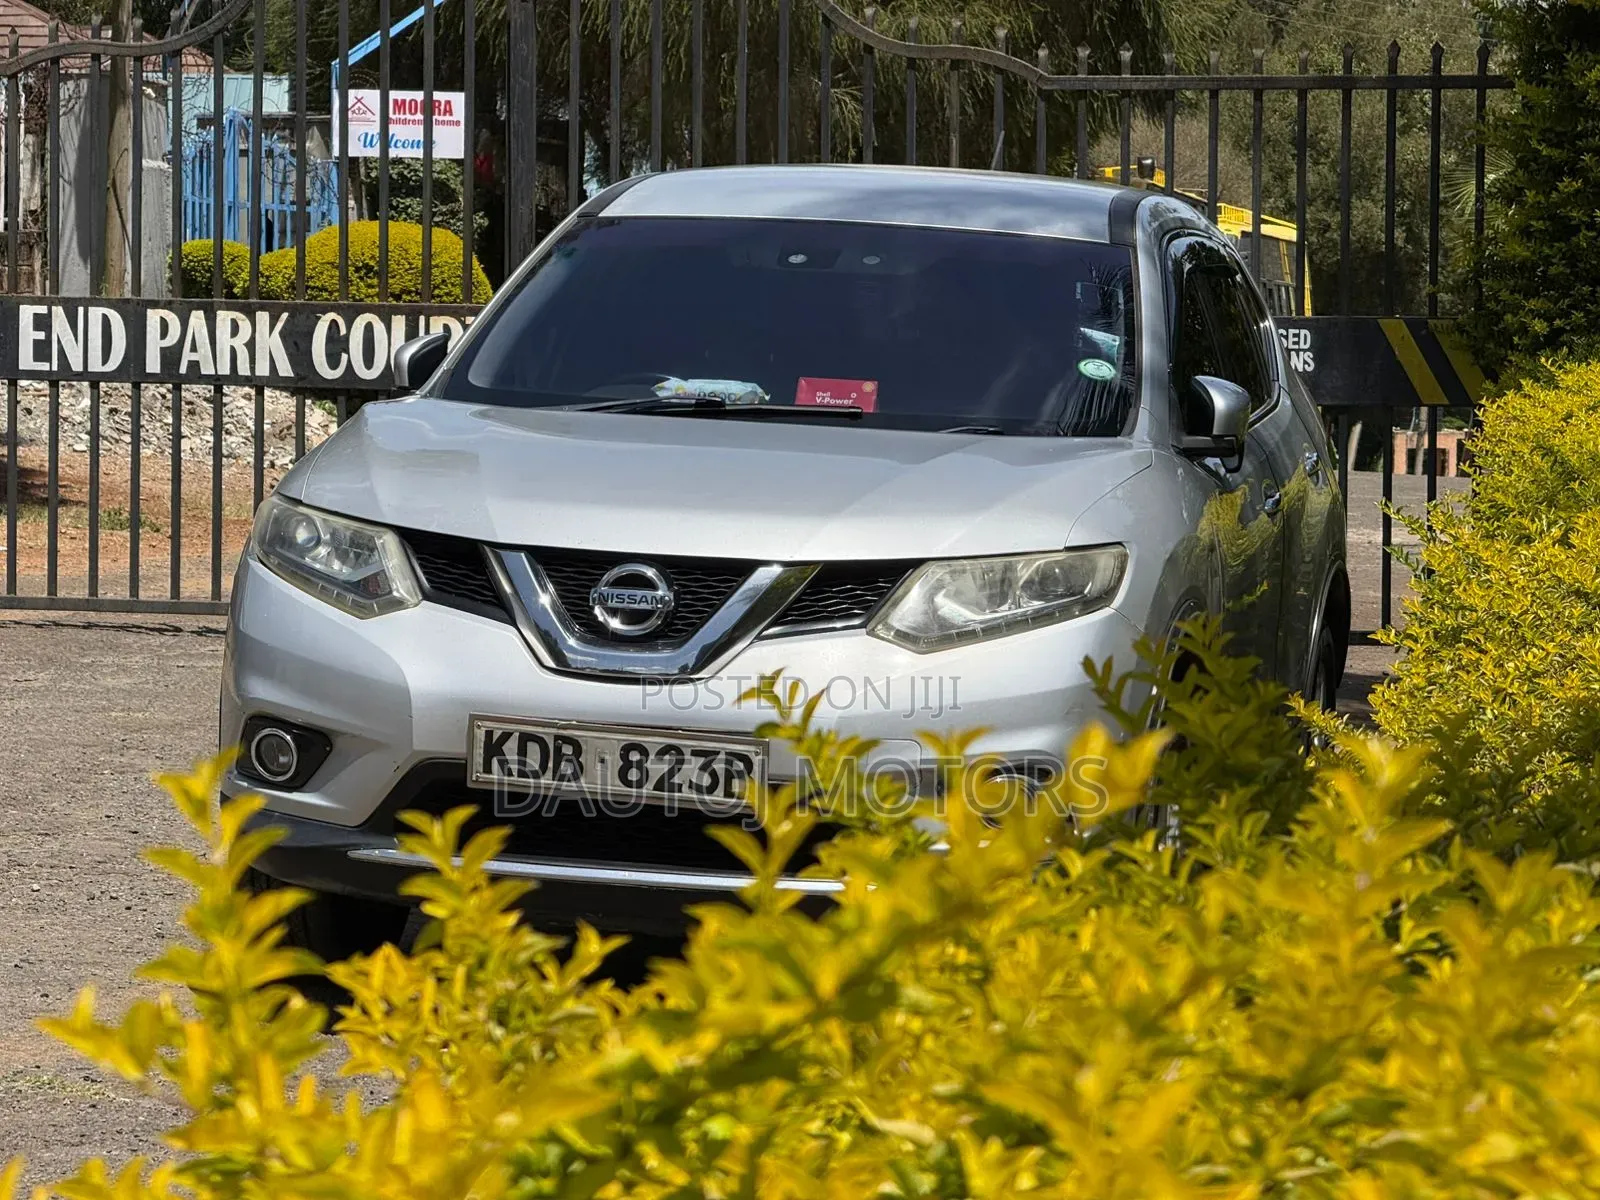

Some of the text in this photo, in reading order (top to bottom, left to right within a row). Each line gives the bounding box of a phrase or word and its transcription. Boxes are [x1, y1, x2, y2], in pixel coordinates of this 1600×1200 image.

[388, 117, 461, 127] hildren home
[357, 132, 436, 149] Wlcom
[18, 305, 127, 372] END
[145, 308, 295, 378] PARK
[815, 397, 854, 405] V-Power
[599, 592, 663, 606] NISSAN
[483, 730, 583, 784] KDB
